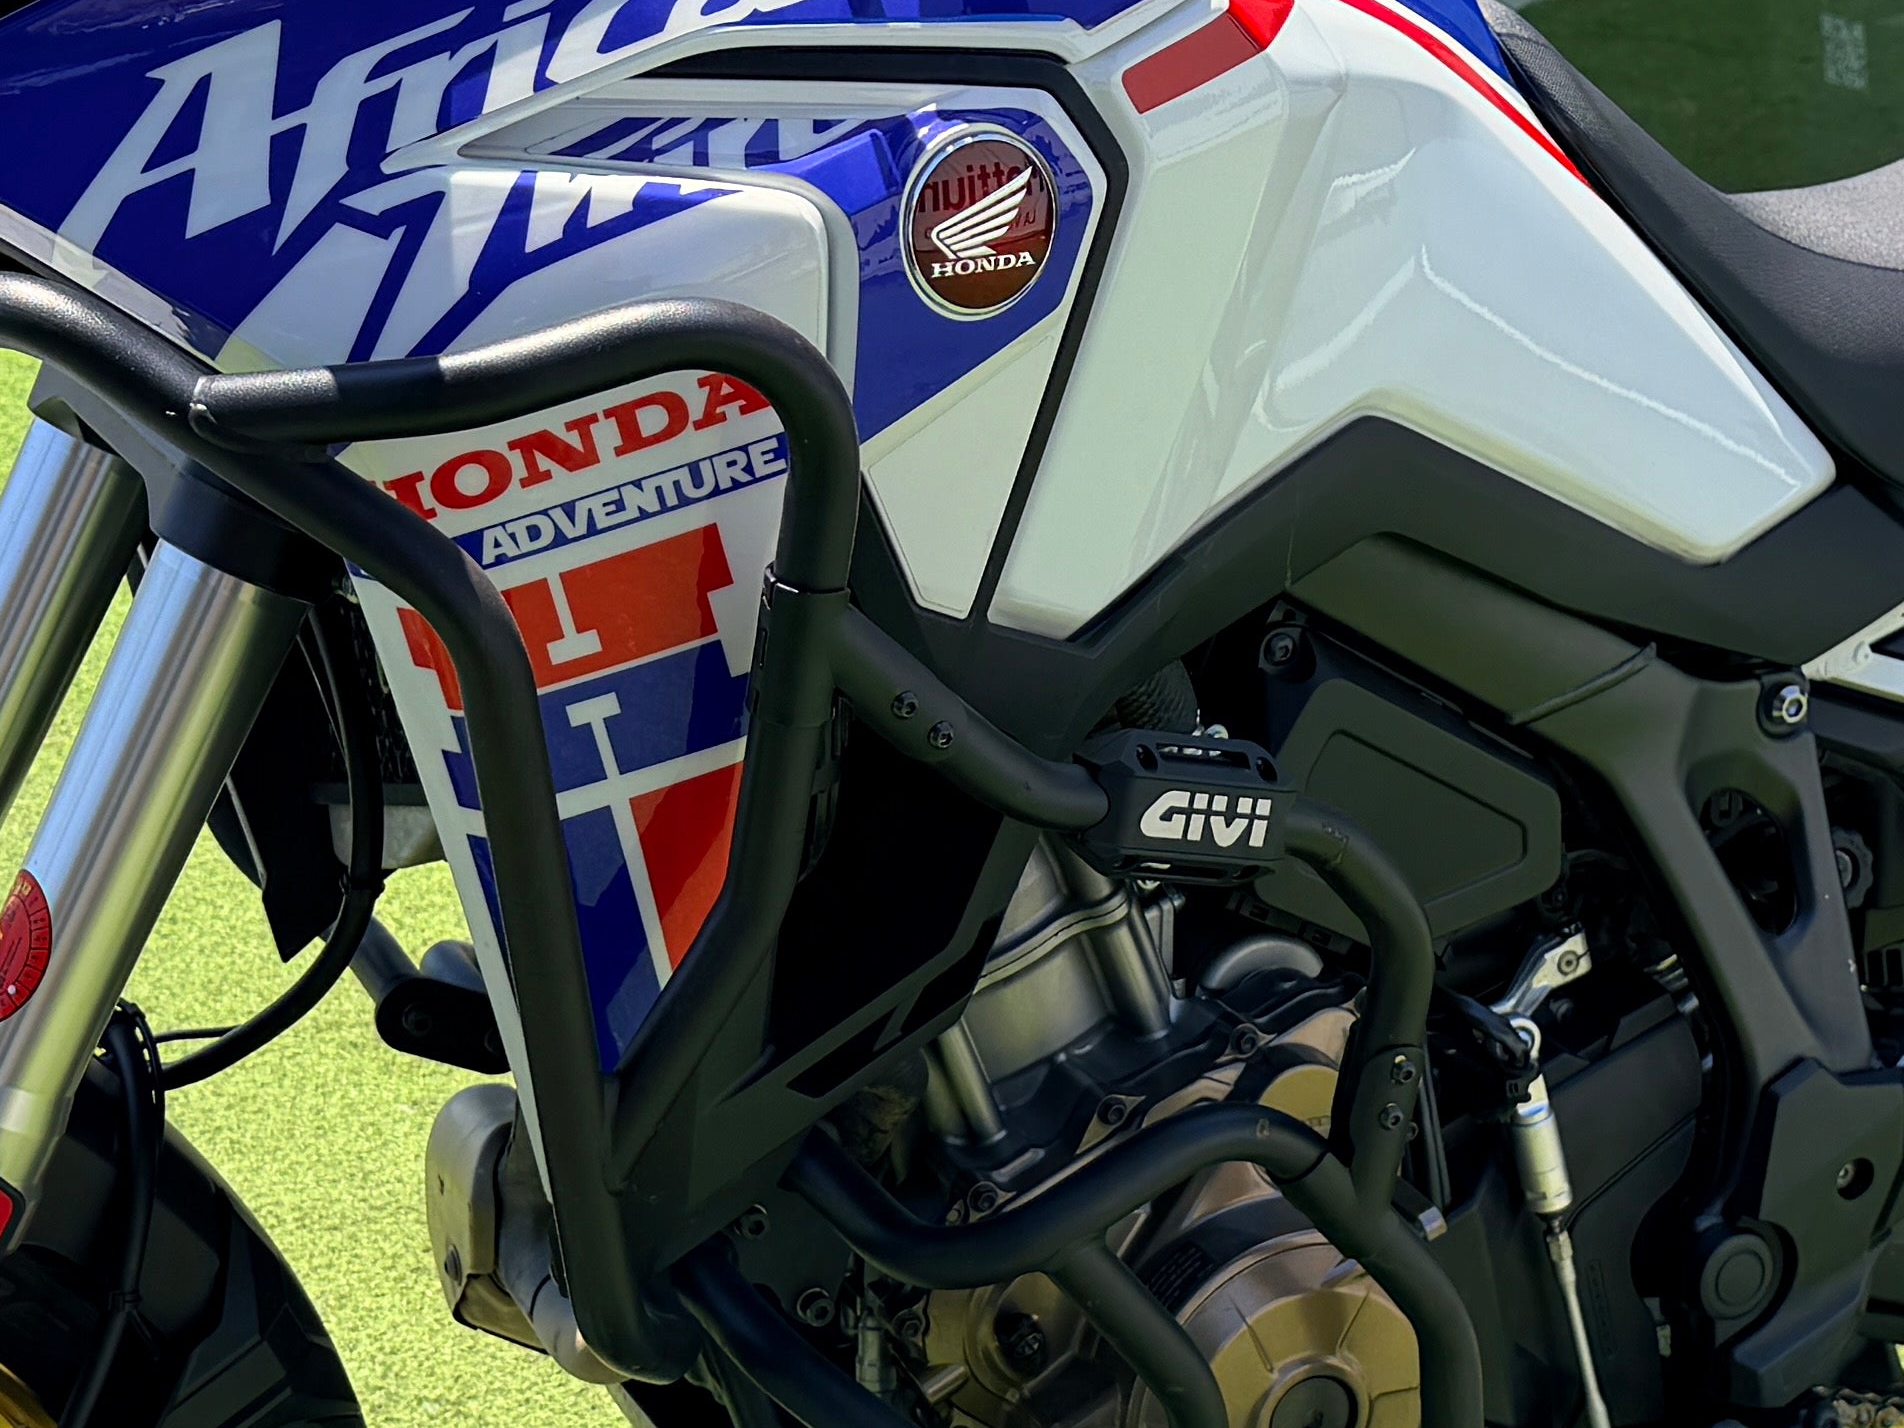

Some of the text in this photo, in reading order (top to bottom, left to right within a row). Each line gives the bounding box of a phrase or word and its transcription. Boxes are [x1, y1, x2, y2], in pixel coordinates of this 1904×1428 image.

[930, 251, 1036, 279] HONDA
[371, 372, 774, 522] HONDA
[481, 437, 787, 567] ADVENTURE
[1138, 789, 1275, 849] GIVI
